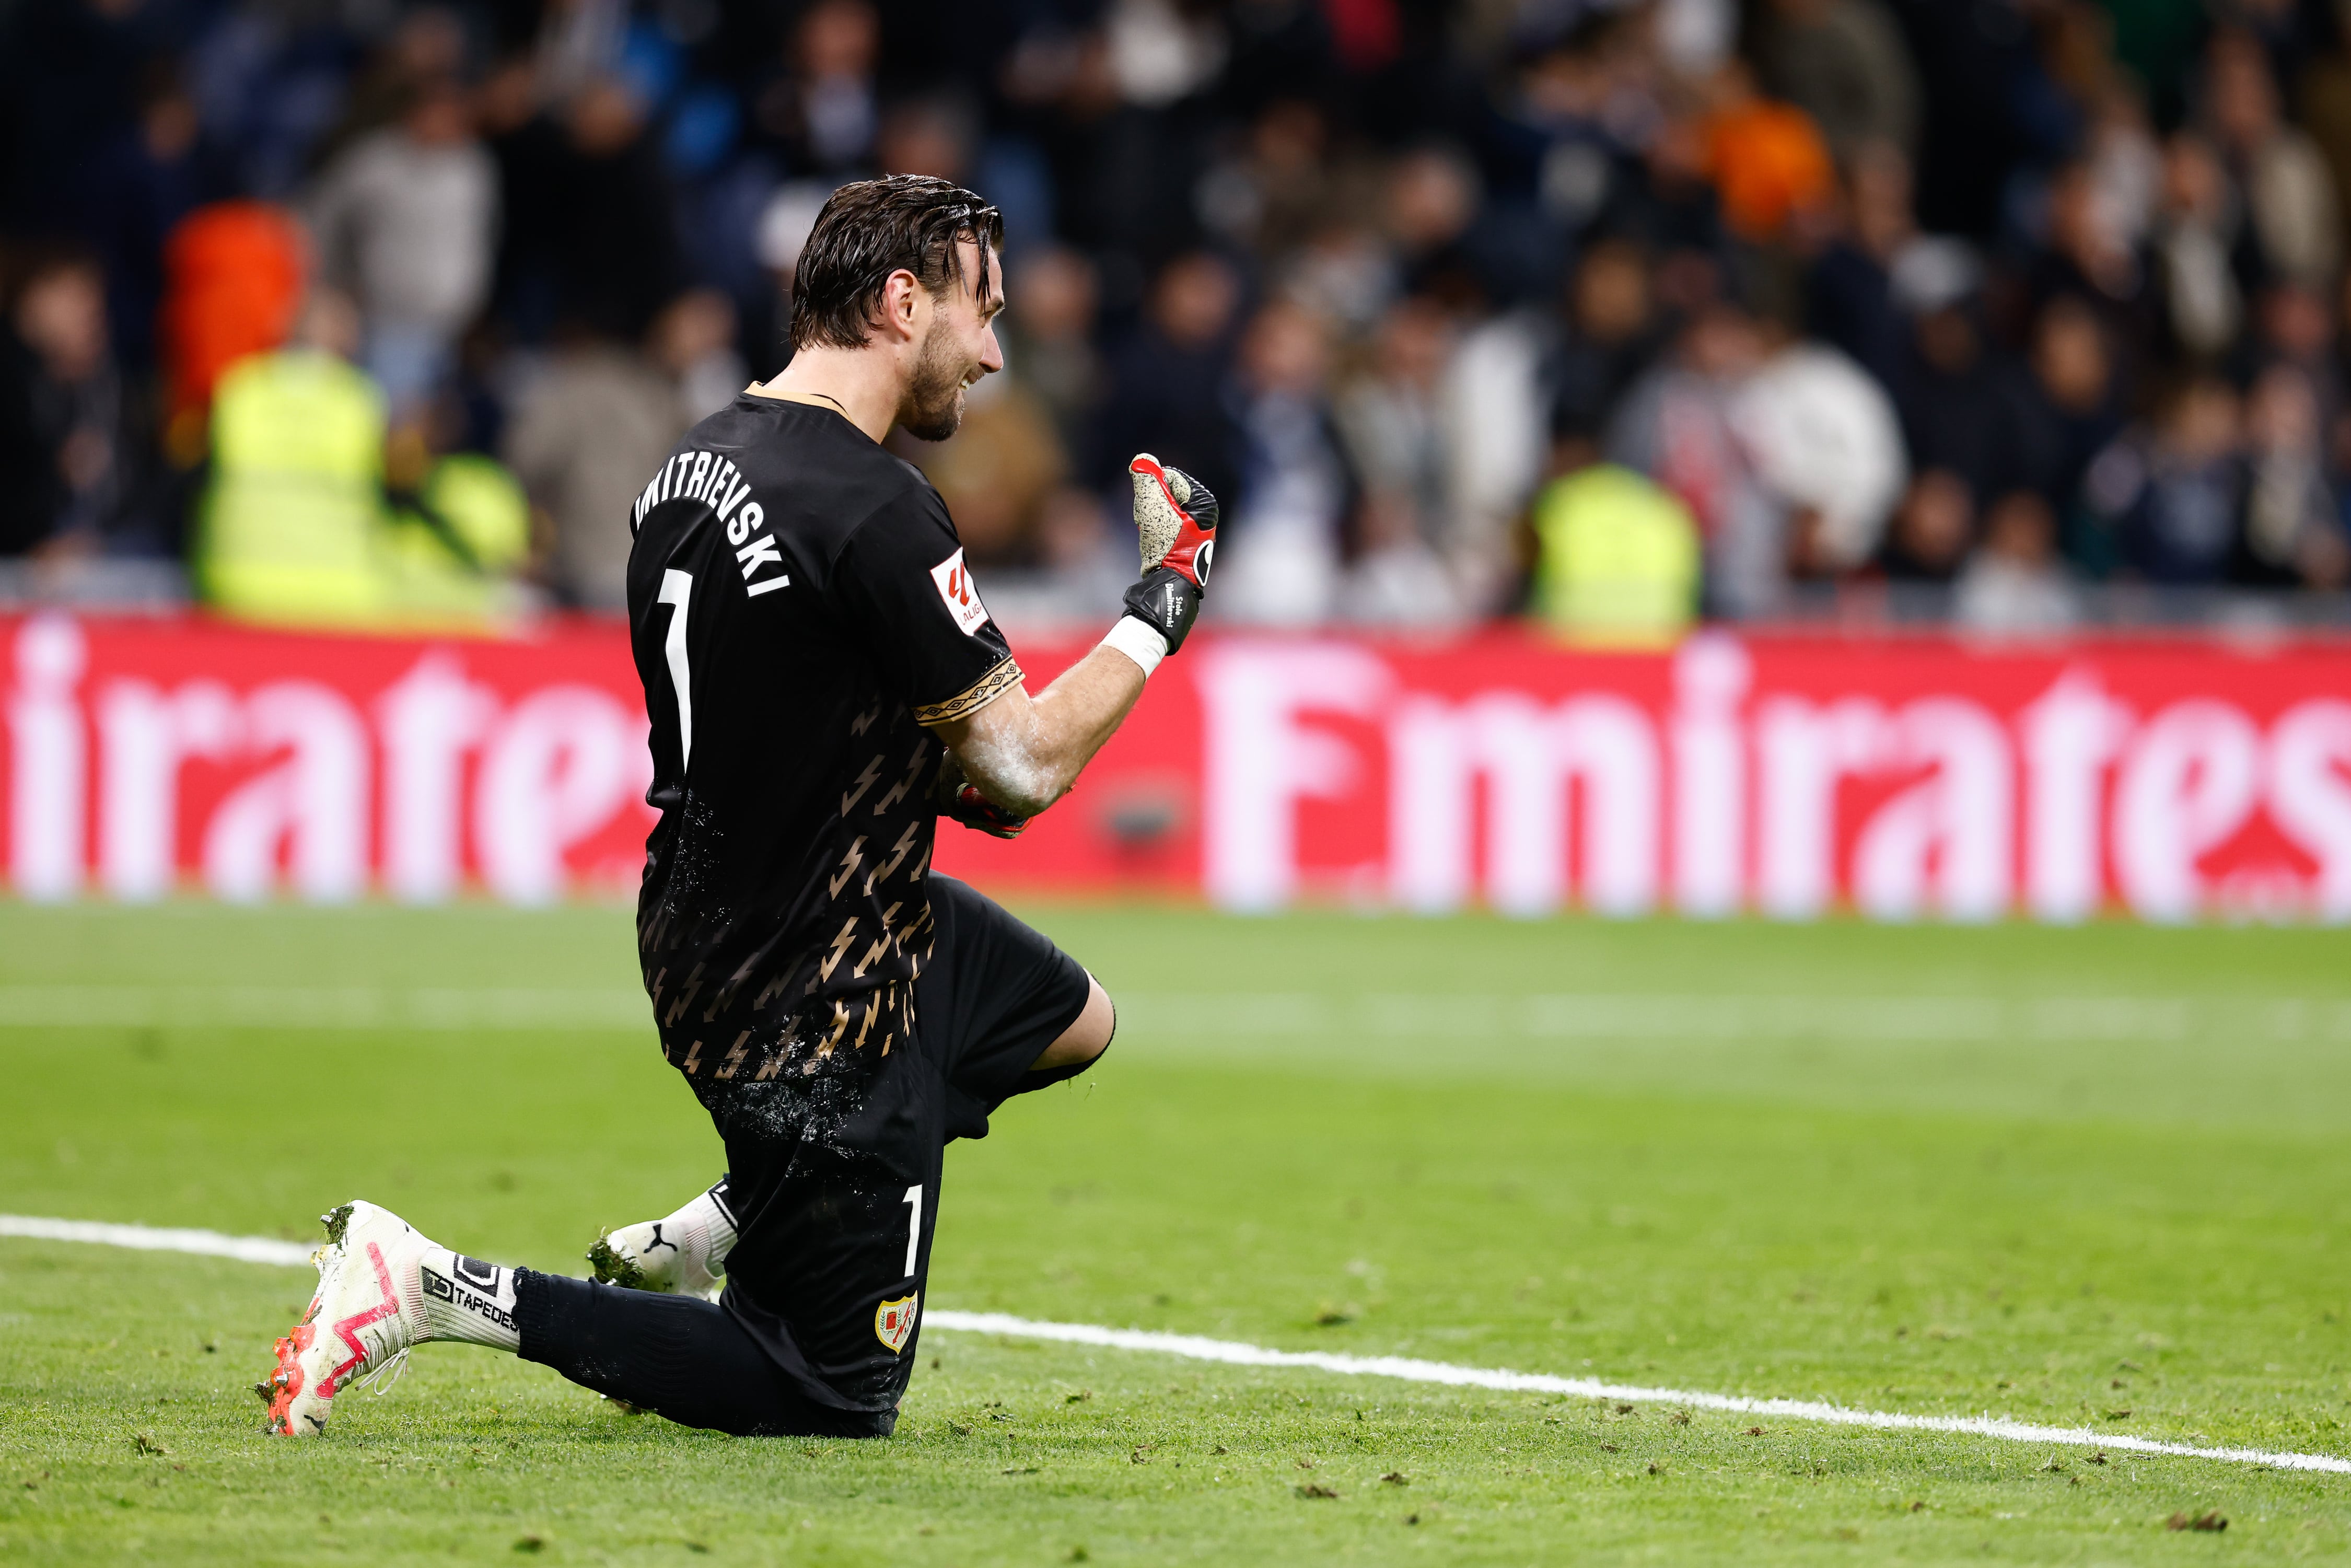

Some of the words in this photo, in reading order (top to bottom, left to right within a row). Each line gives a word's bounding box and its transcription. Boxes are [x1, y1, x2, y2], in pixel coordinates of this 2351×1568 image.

[1165, 583, 1175, 628] Dimitrievski
[1175, 596, 1183, 615] Stole
[657, 568, 693, 774] 1
[1199, 632, 2351, 922] Emirates
[902, 1183, 923, 1278] 1
